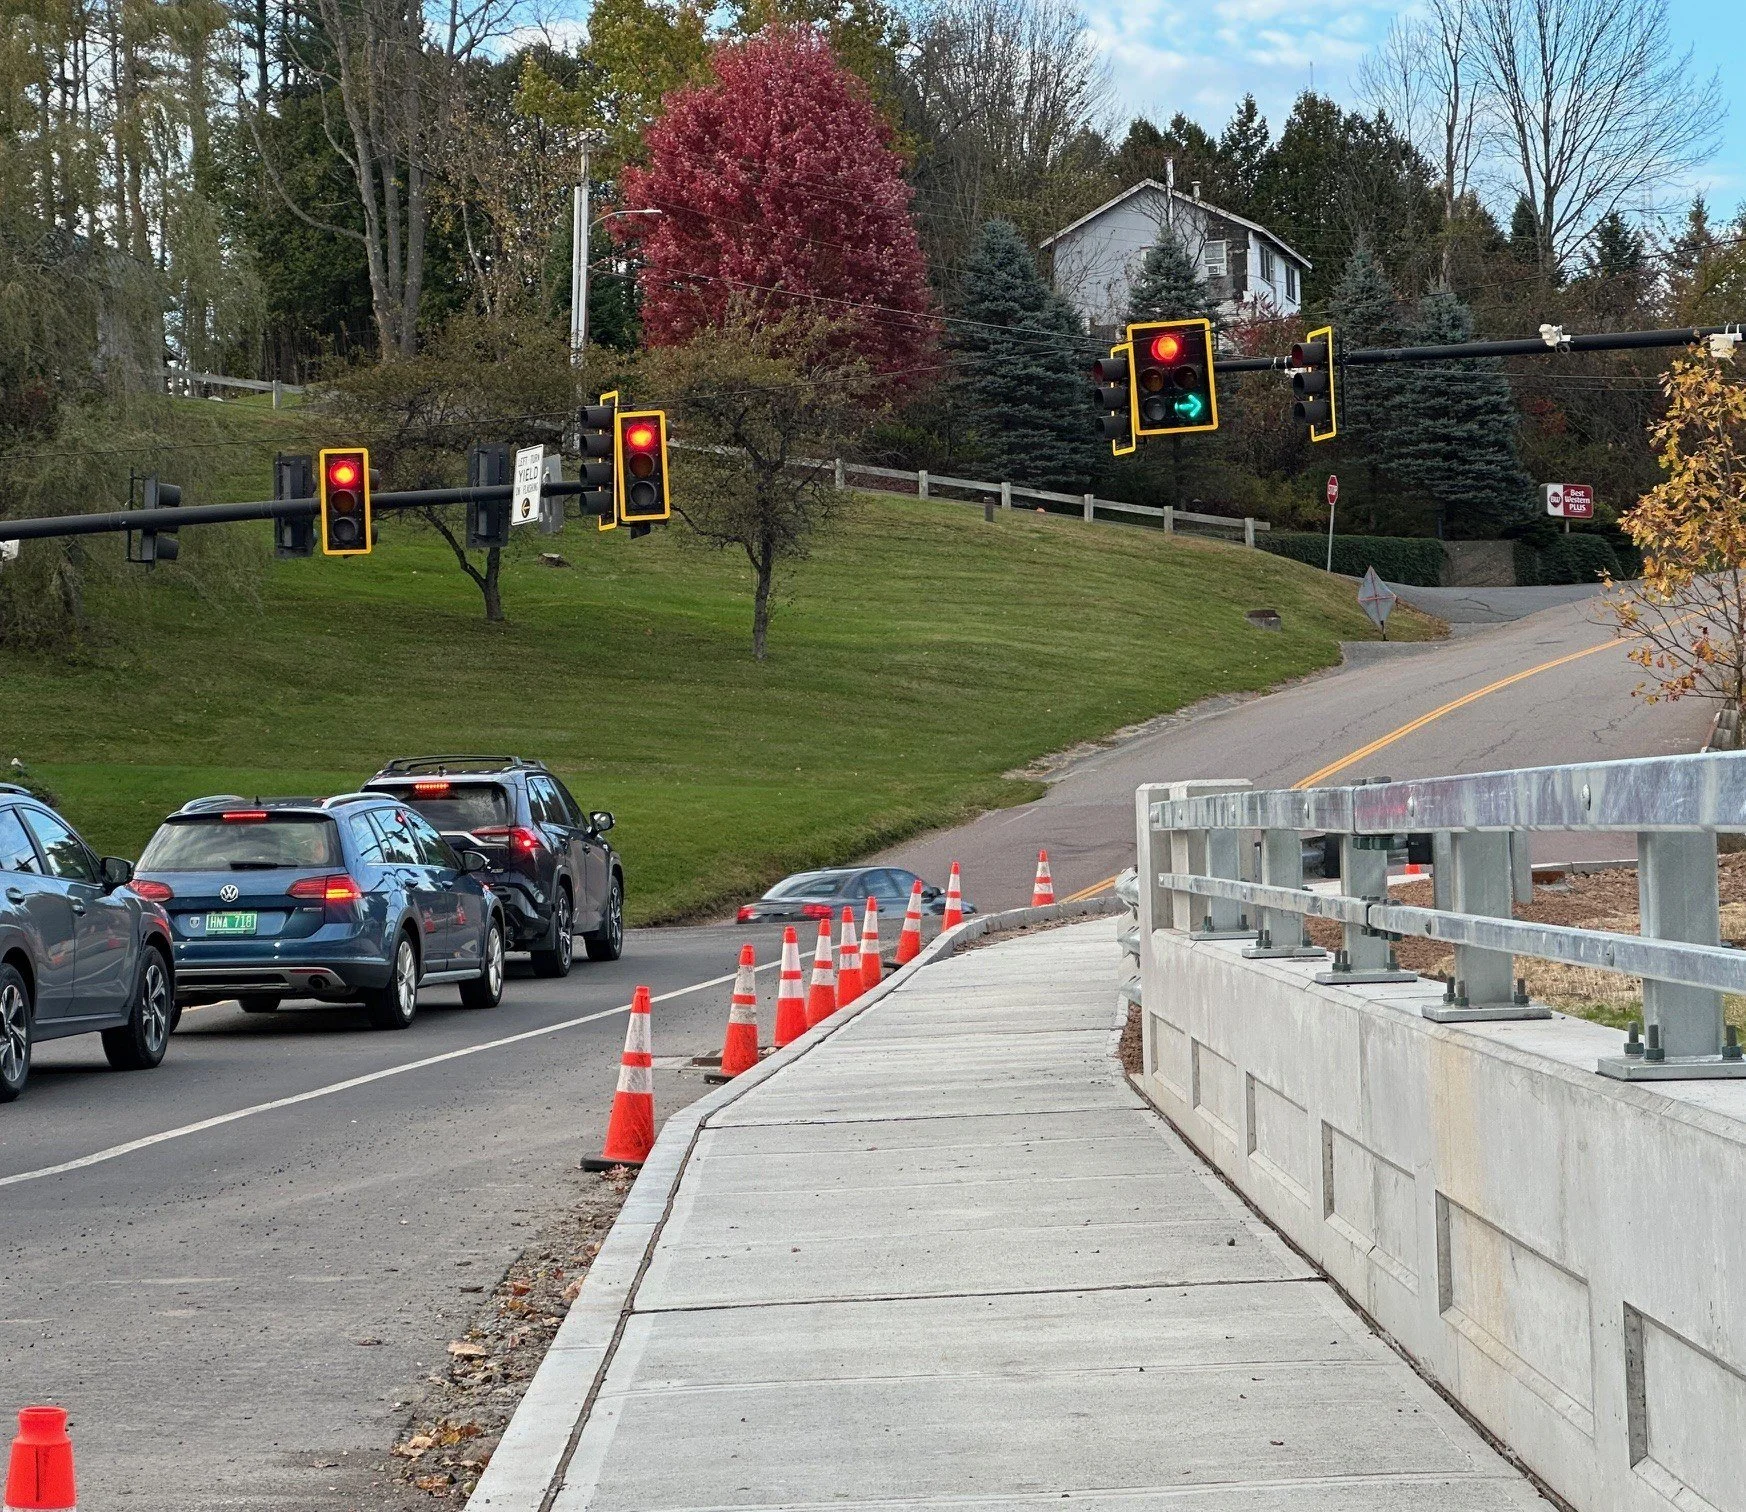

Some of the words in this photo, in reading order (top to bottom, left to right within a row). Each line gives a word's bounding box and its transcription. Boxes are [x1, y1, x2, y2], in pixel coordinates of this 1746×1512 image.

[518, 466, 539, 482] YIELD
[1328, 484, 1338, 495] STOP
[1570, 489, 1585, 497] Best
[1564, 495, 1591, 504] Western
[1569, 503, 1587, 511] PLUS
[210, 916, 228, 928] HNA
[234, 915, 252, 928] 718
